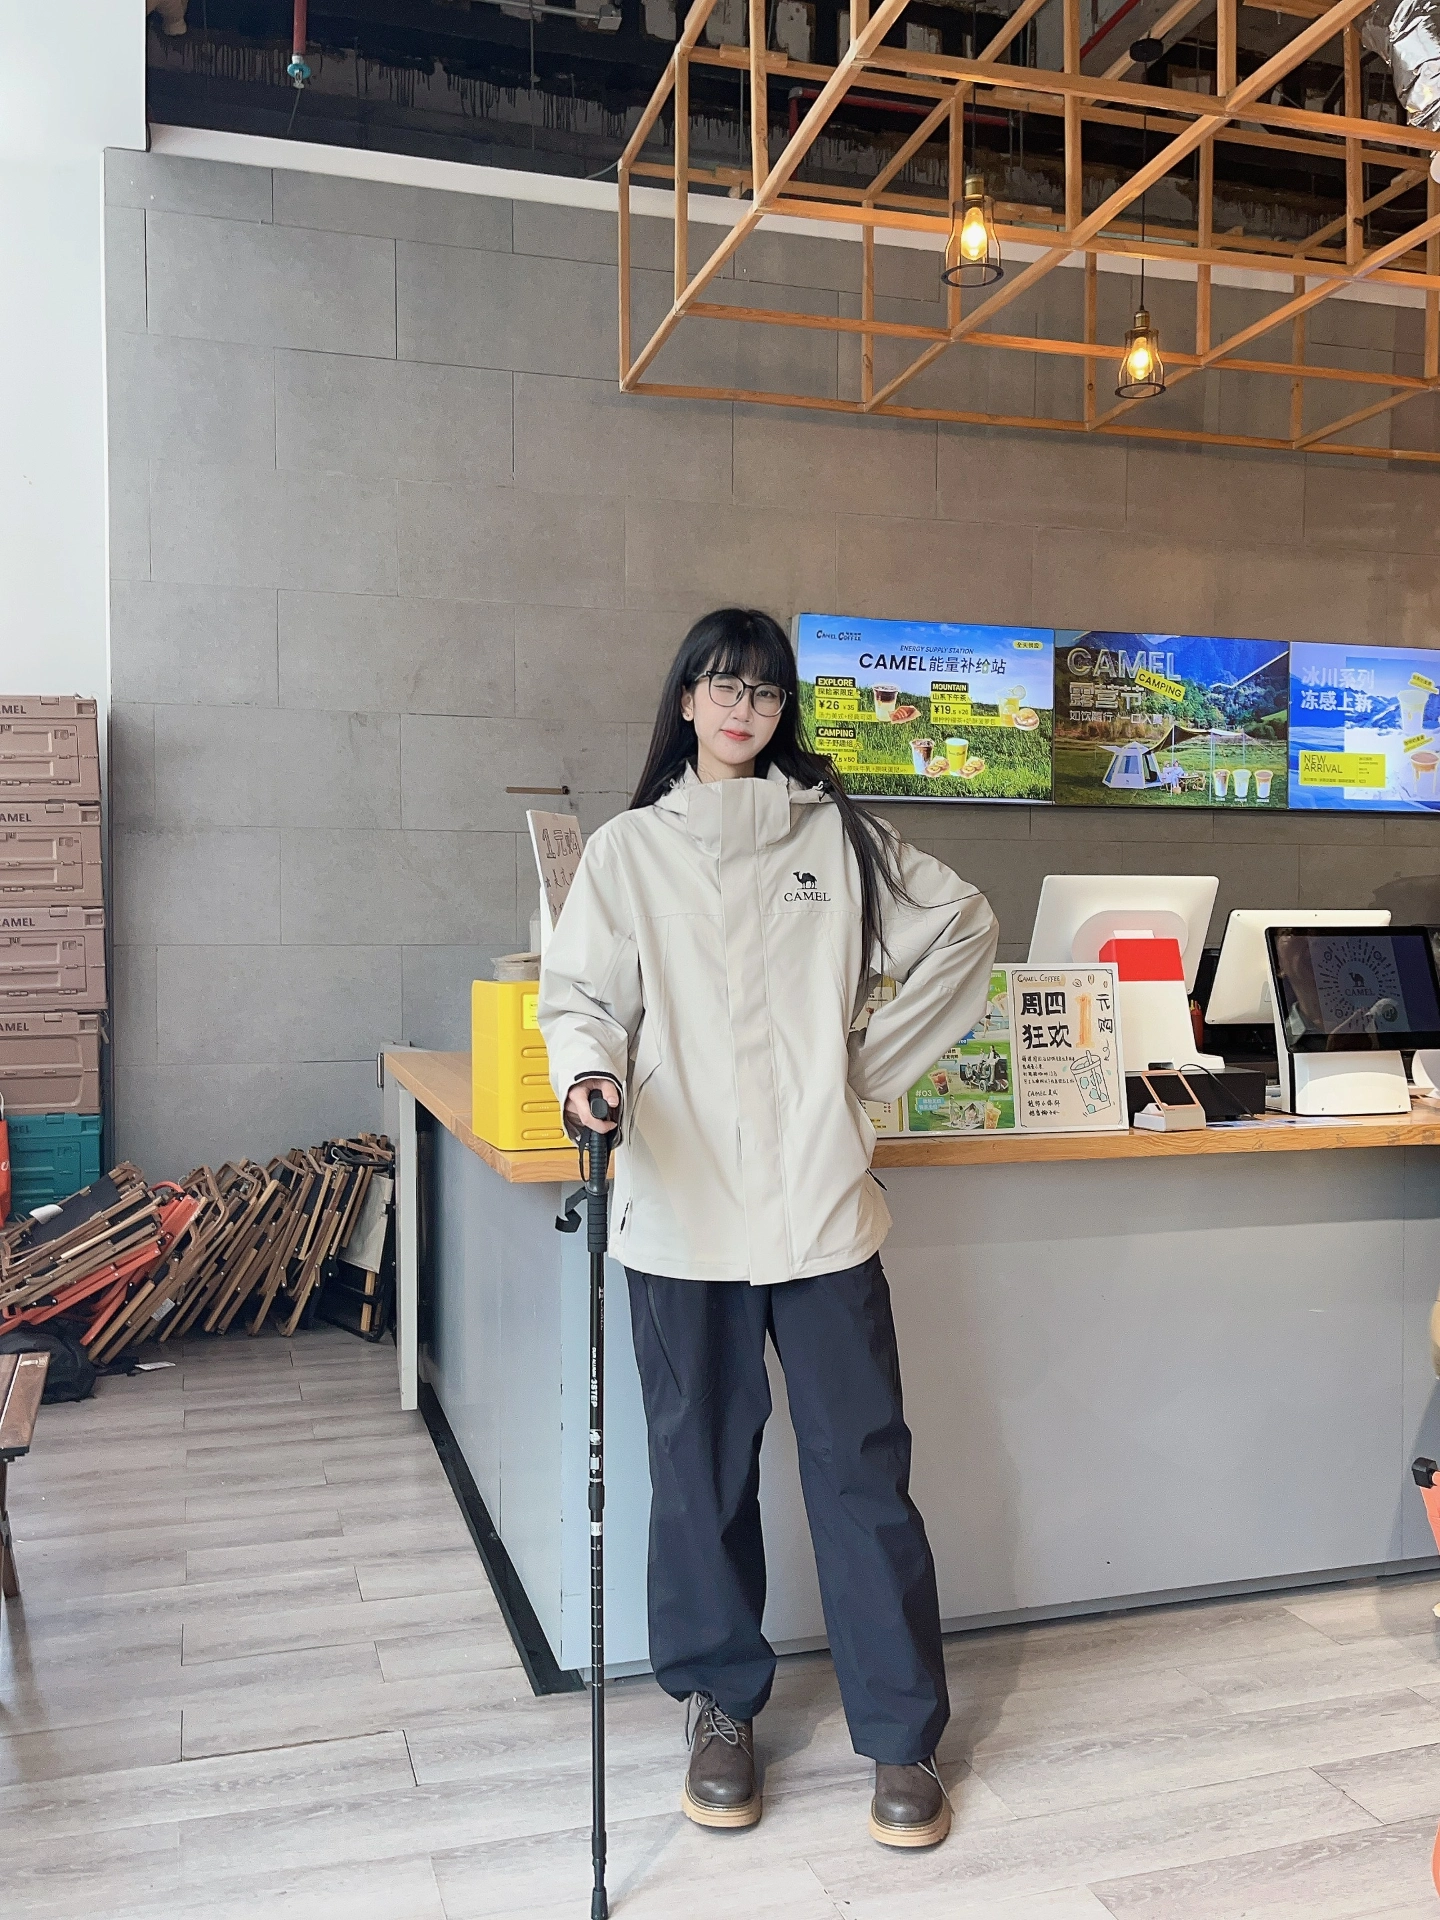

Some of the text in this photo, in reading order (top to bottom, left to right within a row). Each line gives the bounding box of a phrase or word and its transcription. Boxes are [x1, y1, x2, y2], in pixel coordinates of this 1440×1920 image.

[900, 645, 974, 655] ENERGY SUPPLY STATION
[1067, 647, 1181, 681] CAMEL
[818, 678, 854, 687] EXPLORE
[1301, 666, 1375, 689] 冰川系列
[932, 683, 967, 692] MOUNTAIN
[1138, 673, 1182, 698] CAMPING
[819, 700, 840, 710] ¥26
[1301, 690, 1373, 713] 冻感上新
[0, 704, 27, 715] MEL
[818, 727, 854, 737] CAMPING
[1304, 754, 1326, 764] NEW
[1304, 763, 1343, 774] ARRIVAL
[783, 892, 831, 902] CAMEL
[0, 918, 36, 927] AMEL
[1344, 988, 1376, 997] CAMEL
[1020, 991, 1067, 1017] 周四
[1022, 1021, 1072, 1050] 狂欢
[590, 1379, 598, 1408] 3STEP
